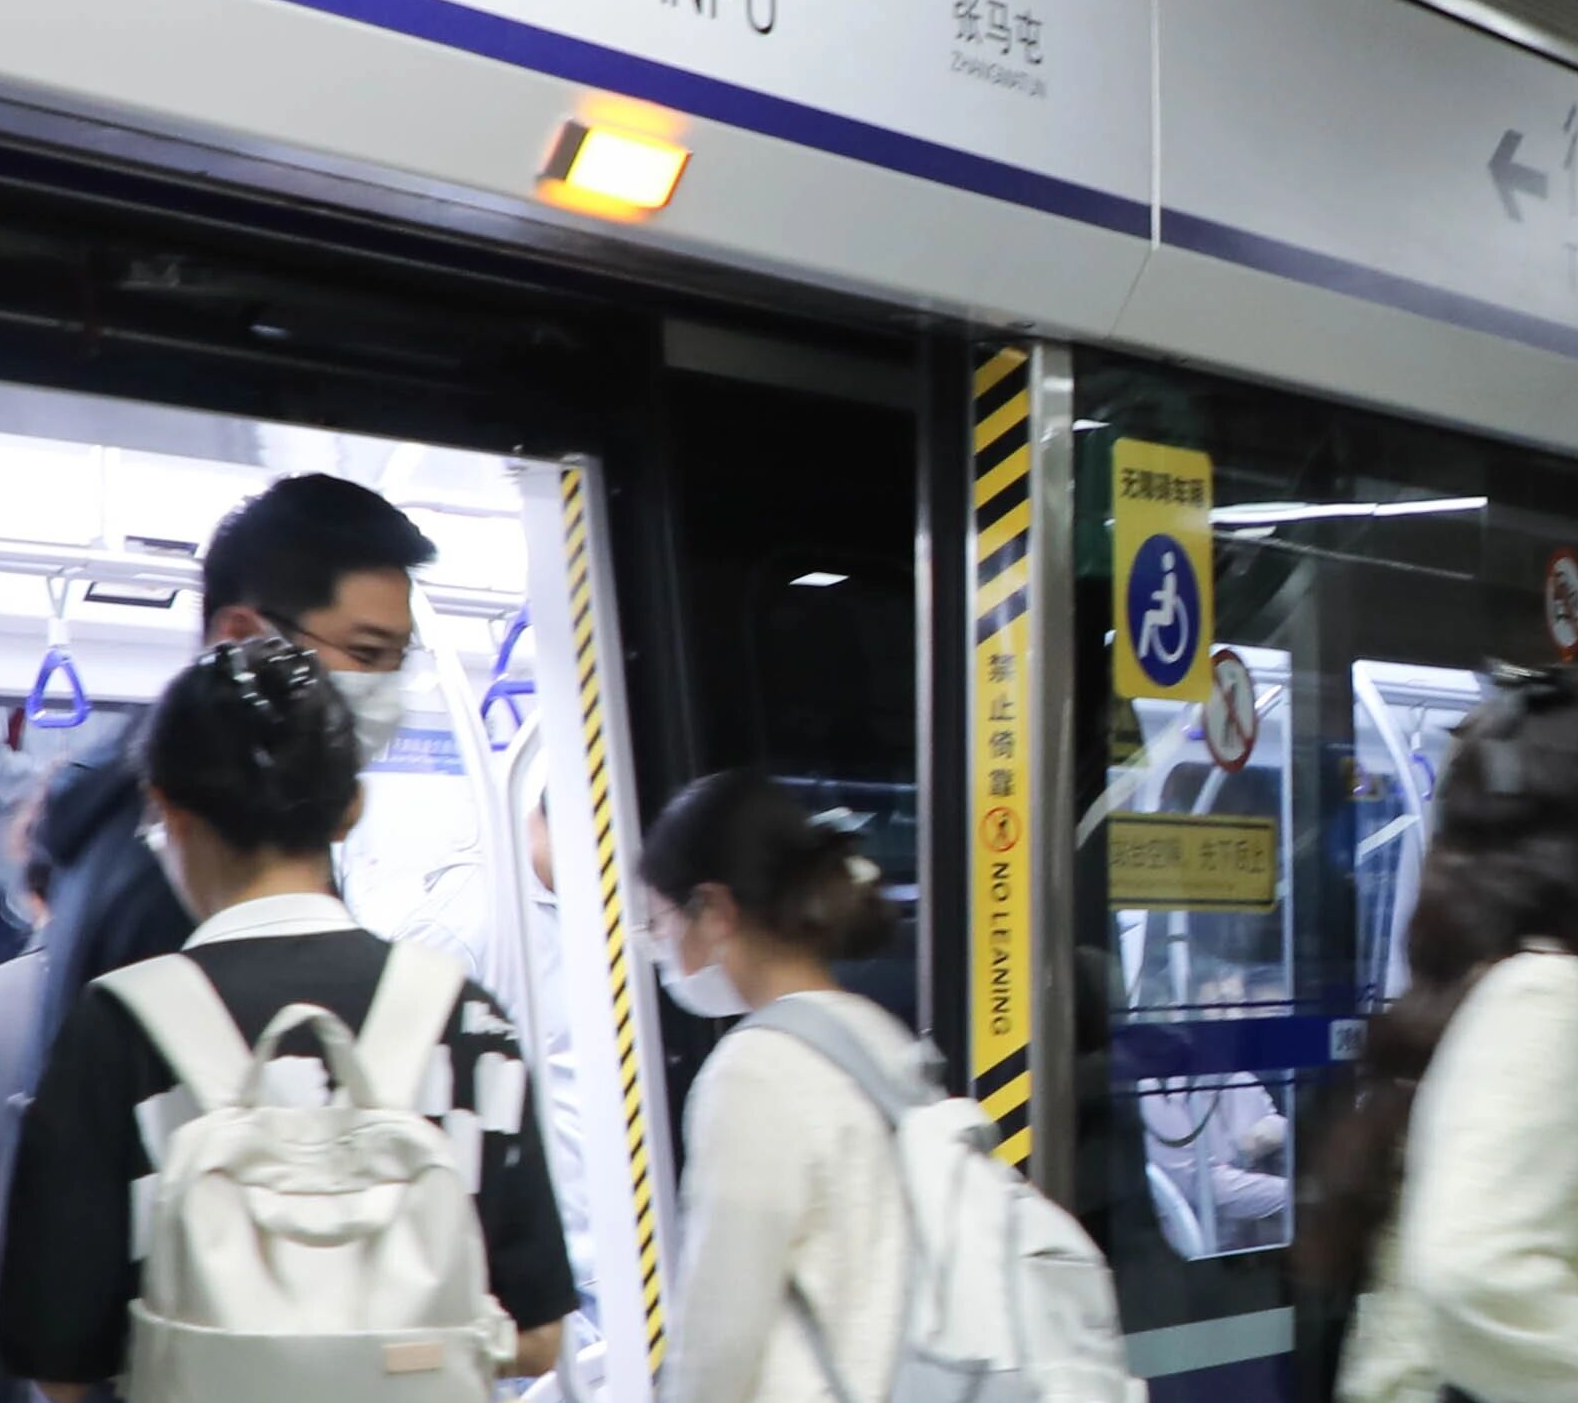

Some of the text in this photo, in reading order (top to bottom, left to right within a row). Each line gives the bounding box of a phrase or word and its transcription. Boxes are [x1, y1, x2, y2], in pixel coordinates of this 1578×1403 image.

[987, 653, 1018, 799] 禁止倚靠
[990, 861, 1015, 1039] NO LEANING
